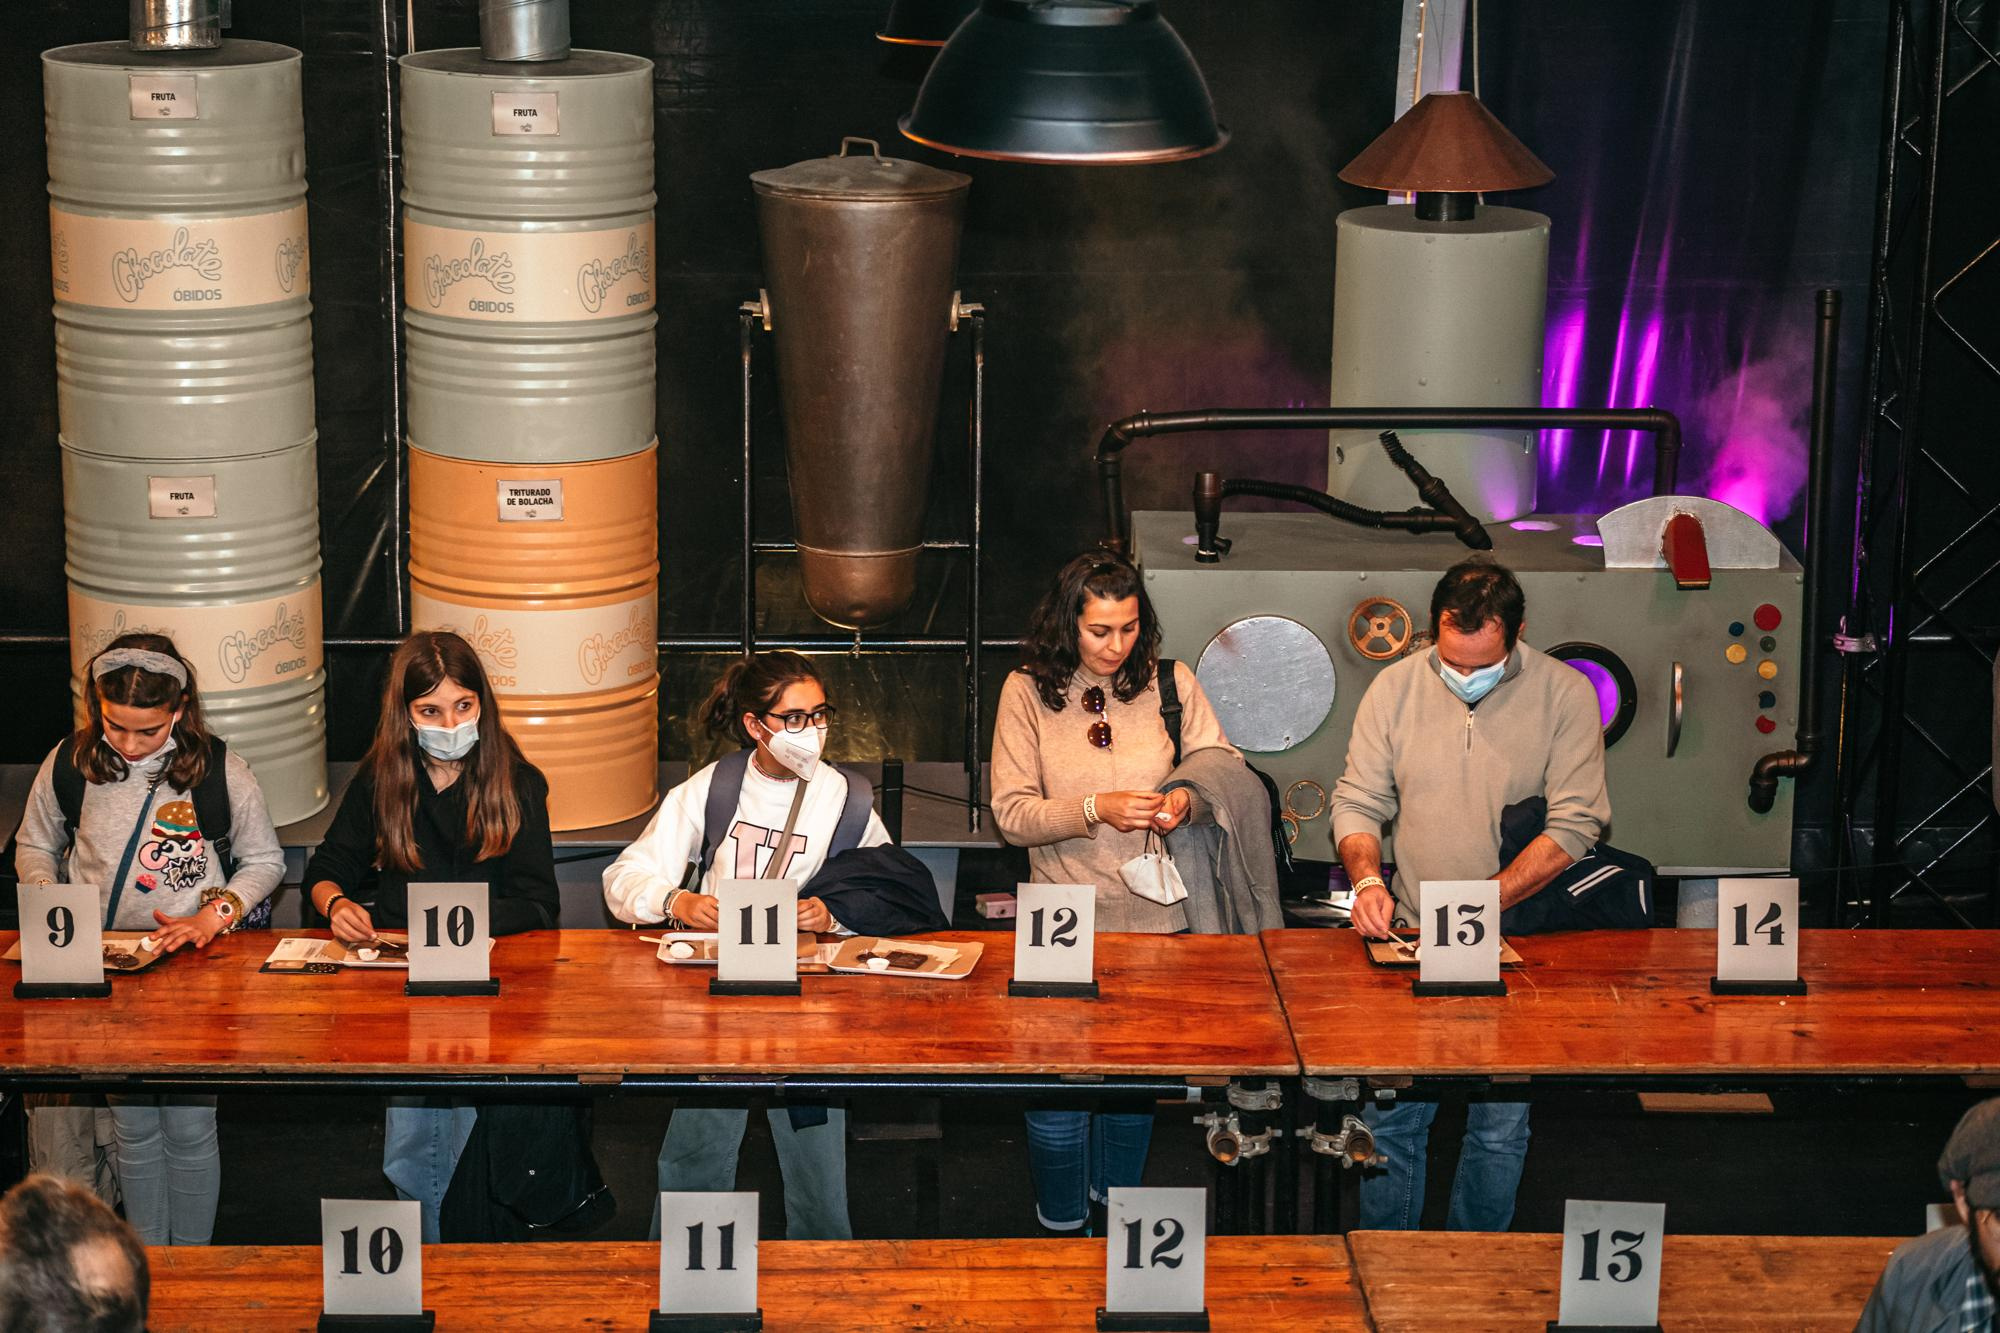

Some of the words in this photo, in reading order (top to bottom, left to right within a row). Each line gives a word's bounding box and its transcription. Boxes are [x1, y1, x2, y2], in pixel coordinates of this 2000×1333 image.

[151, 92, 176, 101] FRUTA
[512, 108, 538, 117] FRUTA
[111, 226, 223, 303] Chocolate
[423, 237, 516, 308] Chocolate
[173, 287, 222, 302] ÓBIDOS
[469, 297, 514, 314] ÓBIDOS
[169, 491, 195, 501] FRUTA
[506, 497, 516, 506] DE
[518, 496, 554, 506] BOLACHA
[509, 488, 551, 497] TRITURADO
[218, 602, 306, 684] Chocolate
[169, 861, 205, 886] BANG
[46, 906, 75, 948] 9
[423, 905, 475, 947] 10
[738, 904, 781, 945] 11
[1028, 907, 1078, 948] 12
[1433, 904, 1485, 947] 13
[1732, 902, 1785, 946] 14
[339, 1225, 404, 1275] 10
[685, 1221, 737, 1271] 11
[1123, 1217, 1185, 1270] 12
[1578, 1228, 1646, 1283] 13
